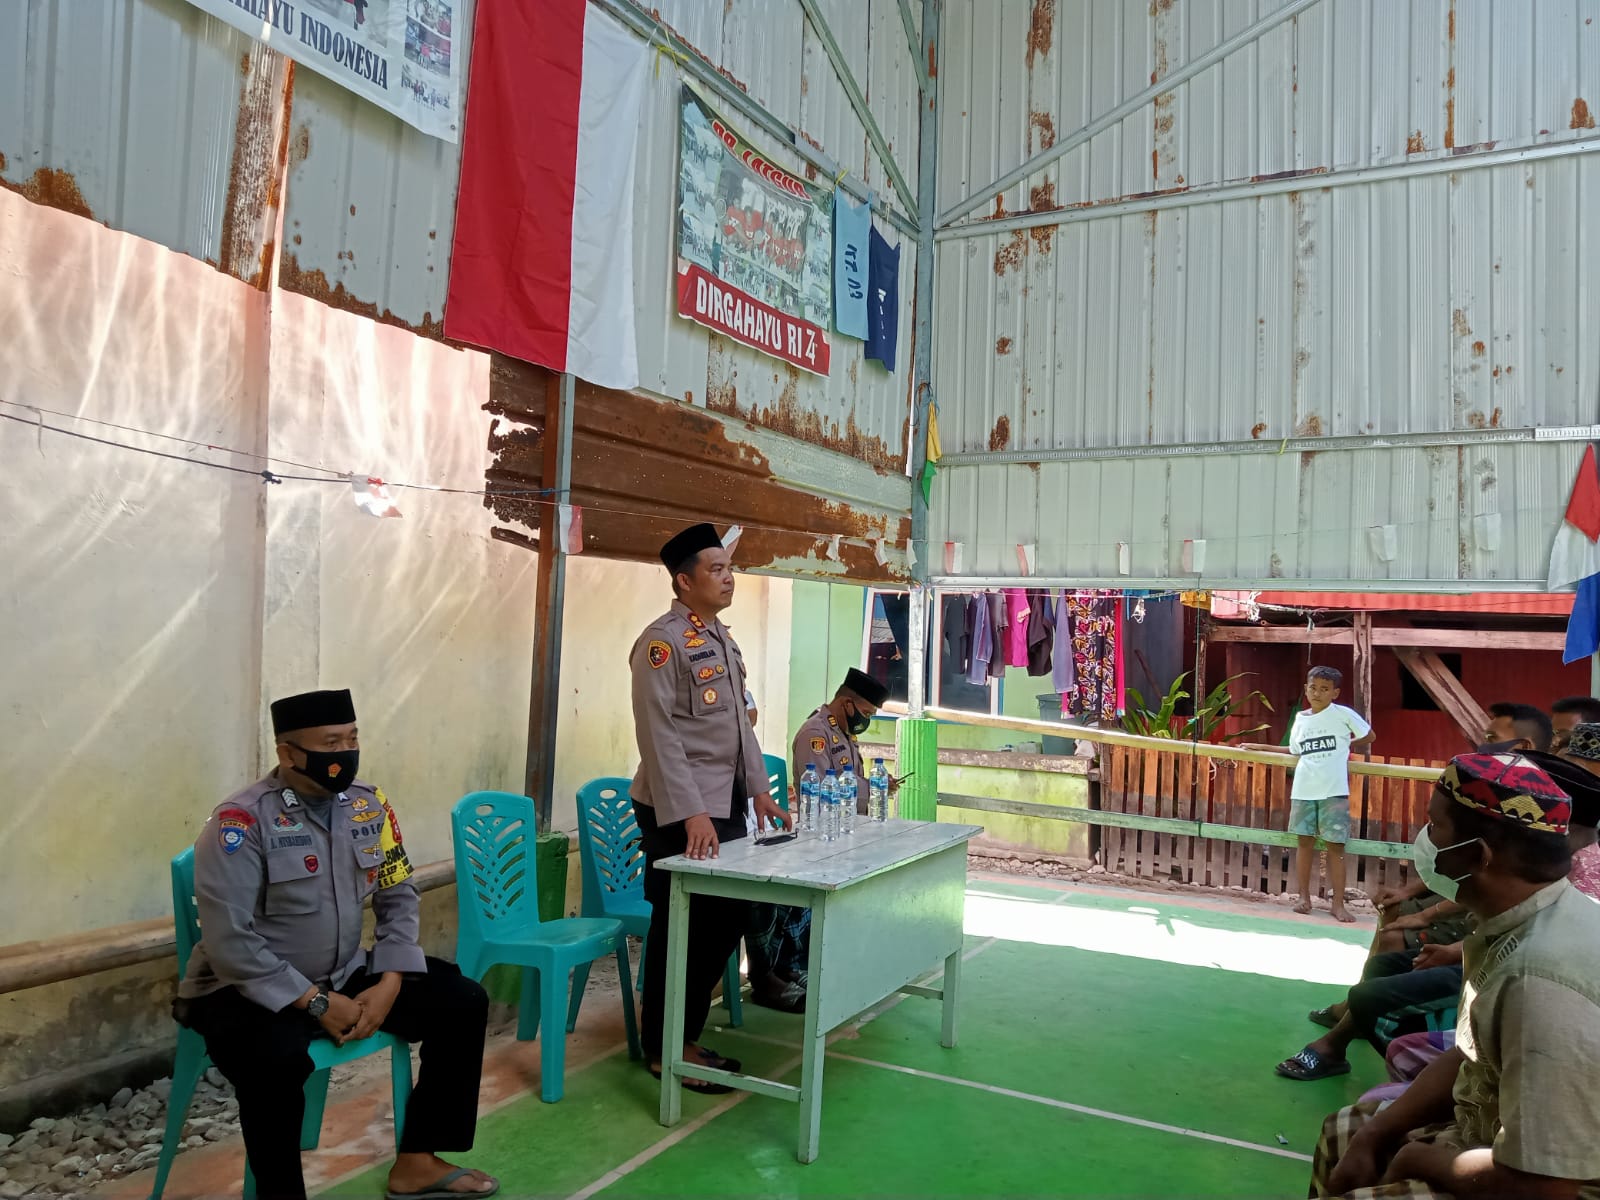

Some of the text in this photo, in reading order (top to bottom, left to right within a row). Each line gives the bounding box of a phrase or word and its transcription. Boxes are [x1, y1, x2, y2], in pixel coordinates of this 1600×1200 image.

[300, 12, 388, 90] INDONESIA
[696, 276, 782, 350] DIRGAHAYU
[787, 322, 802, 359] RI
[1292, 1051, 1316, 1070] OSS
